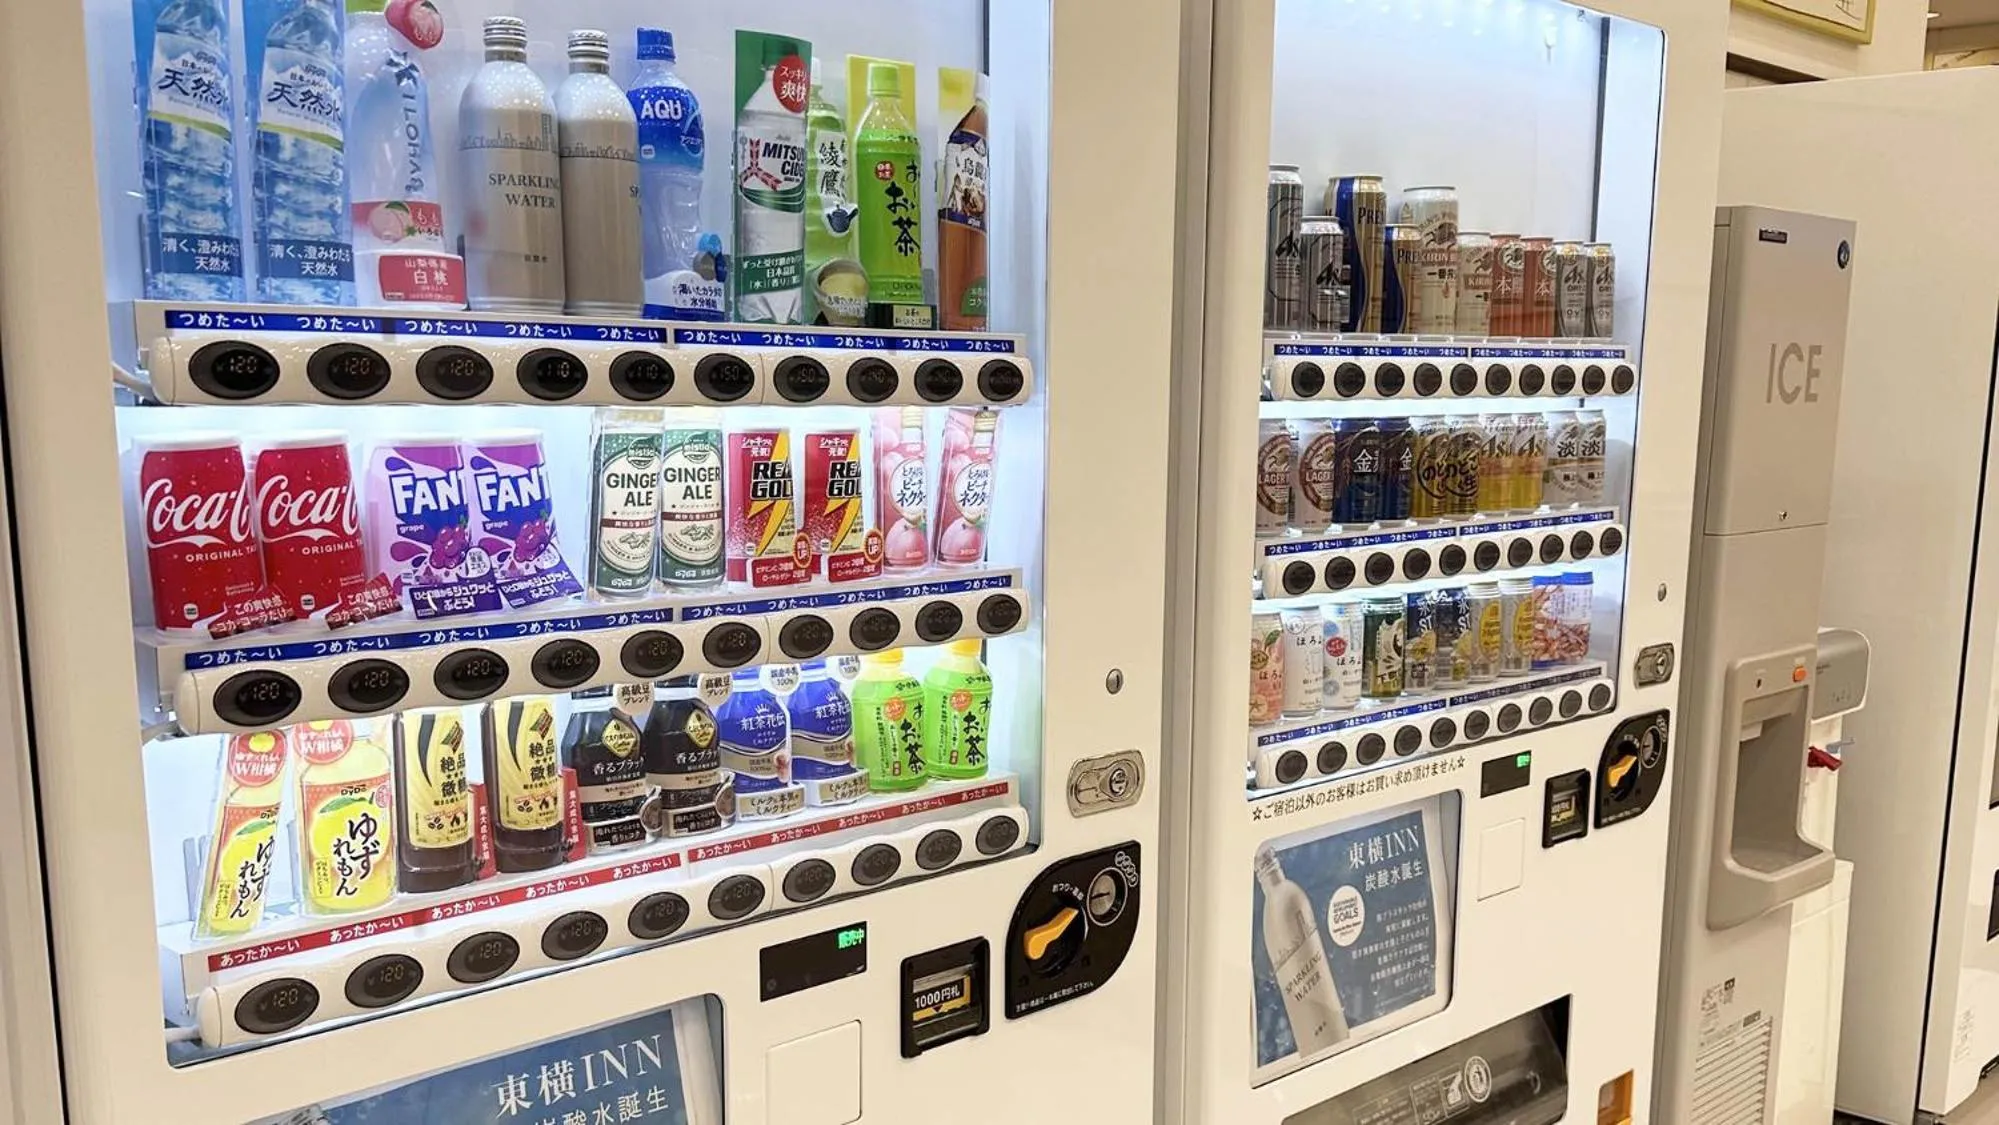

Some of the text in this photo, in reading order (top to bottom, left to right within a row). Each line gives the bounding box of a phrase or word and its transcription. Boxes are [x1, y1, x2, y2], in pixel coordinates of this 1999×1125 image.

[505, 193, 556, 209] WATER
[884, 181, 921, 257] お茶
[301, 262, 338, 276] 天然水
[228, 357, 257, 374] 120
[1766, 342, 1823, 405] ICE
[624, 491, 653, 507] ALE
[682, 485, 713, 500] ALE
[400, 523, 425, 533] grape
[485, 520, 508, 530] grape
[185, 548, 244, 563] ORIGINAL
[302, 541, 355, 556] ORIGINAL
[251, 682, 279, 701] 120
[901, 718, 926, 775] お茶
[963, 711, 986, 766] お茶
[349, 812, 381, 881] ゆず
[1348, 825, 1419, 870] 東横INN
[333, 838, 358, 897] れもん
[914, 984, 960, 1009] 1000円札
[491, 1034, 662, 1119] 東横INN
[535, 1085, 669, 1125] 酸水誕生
